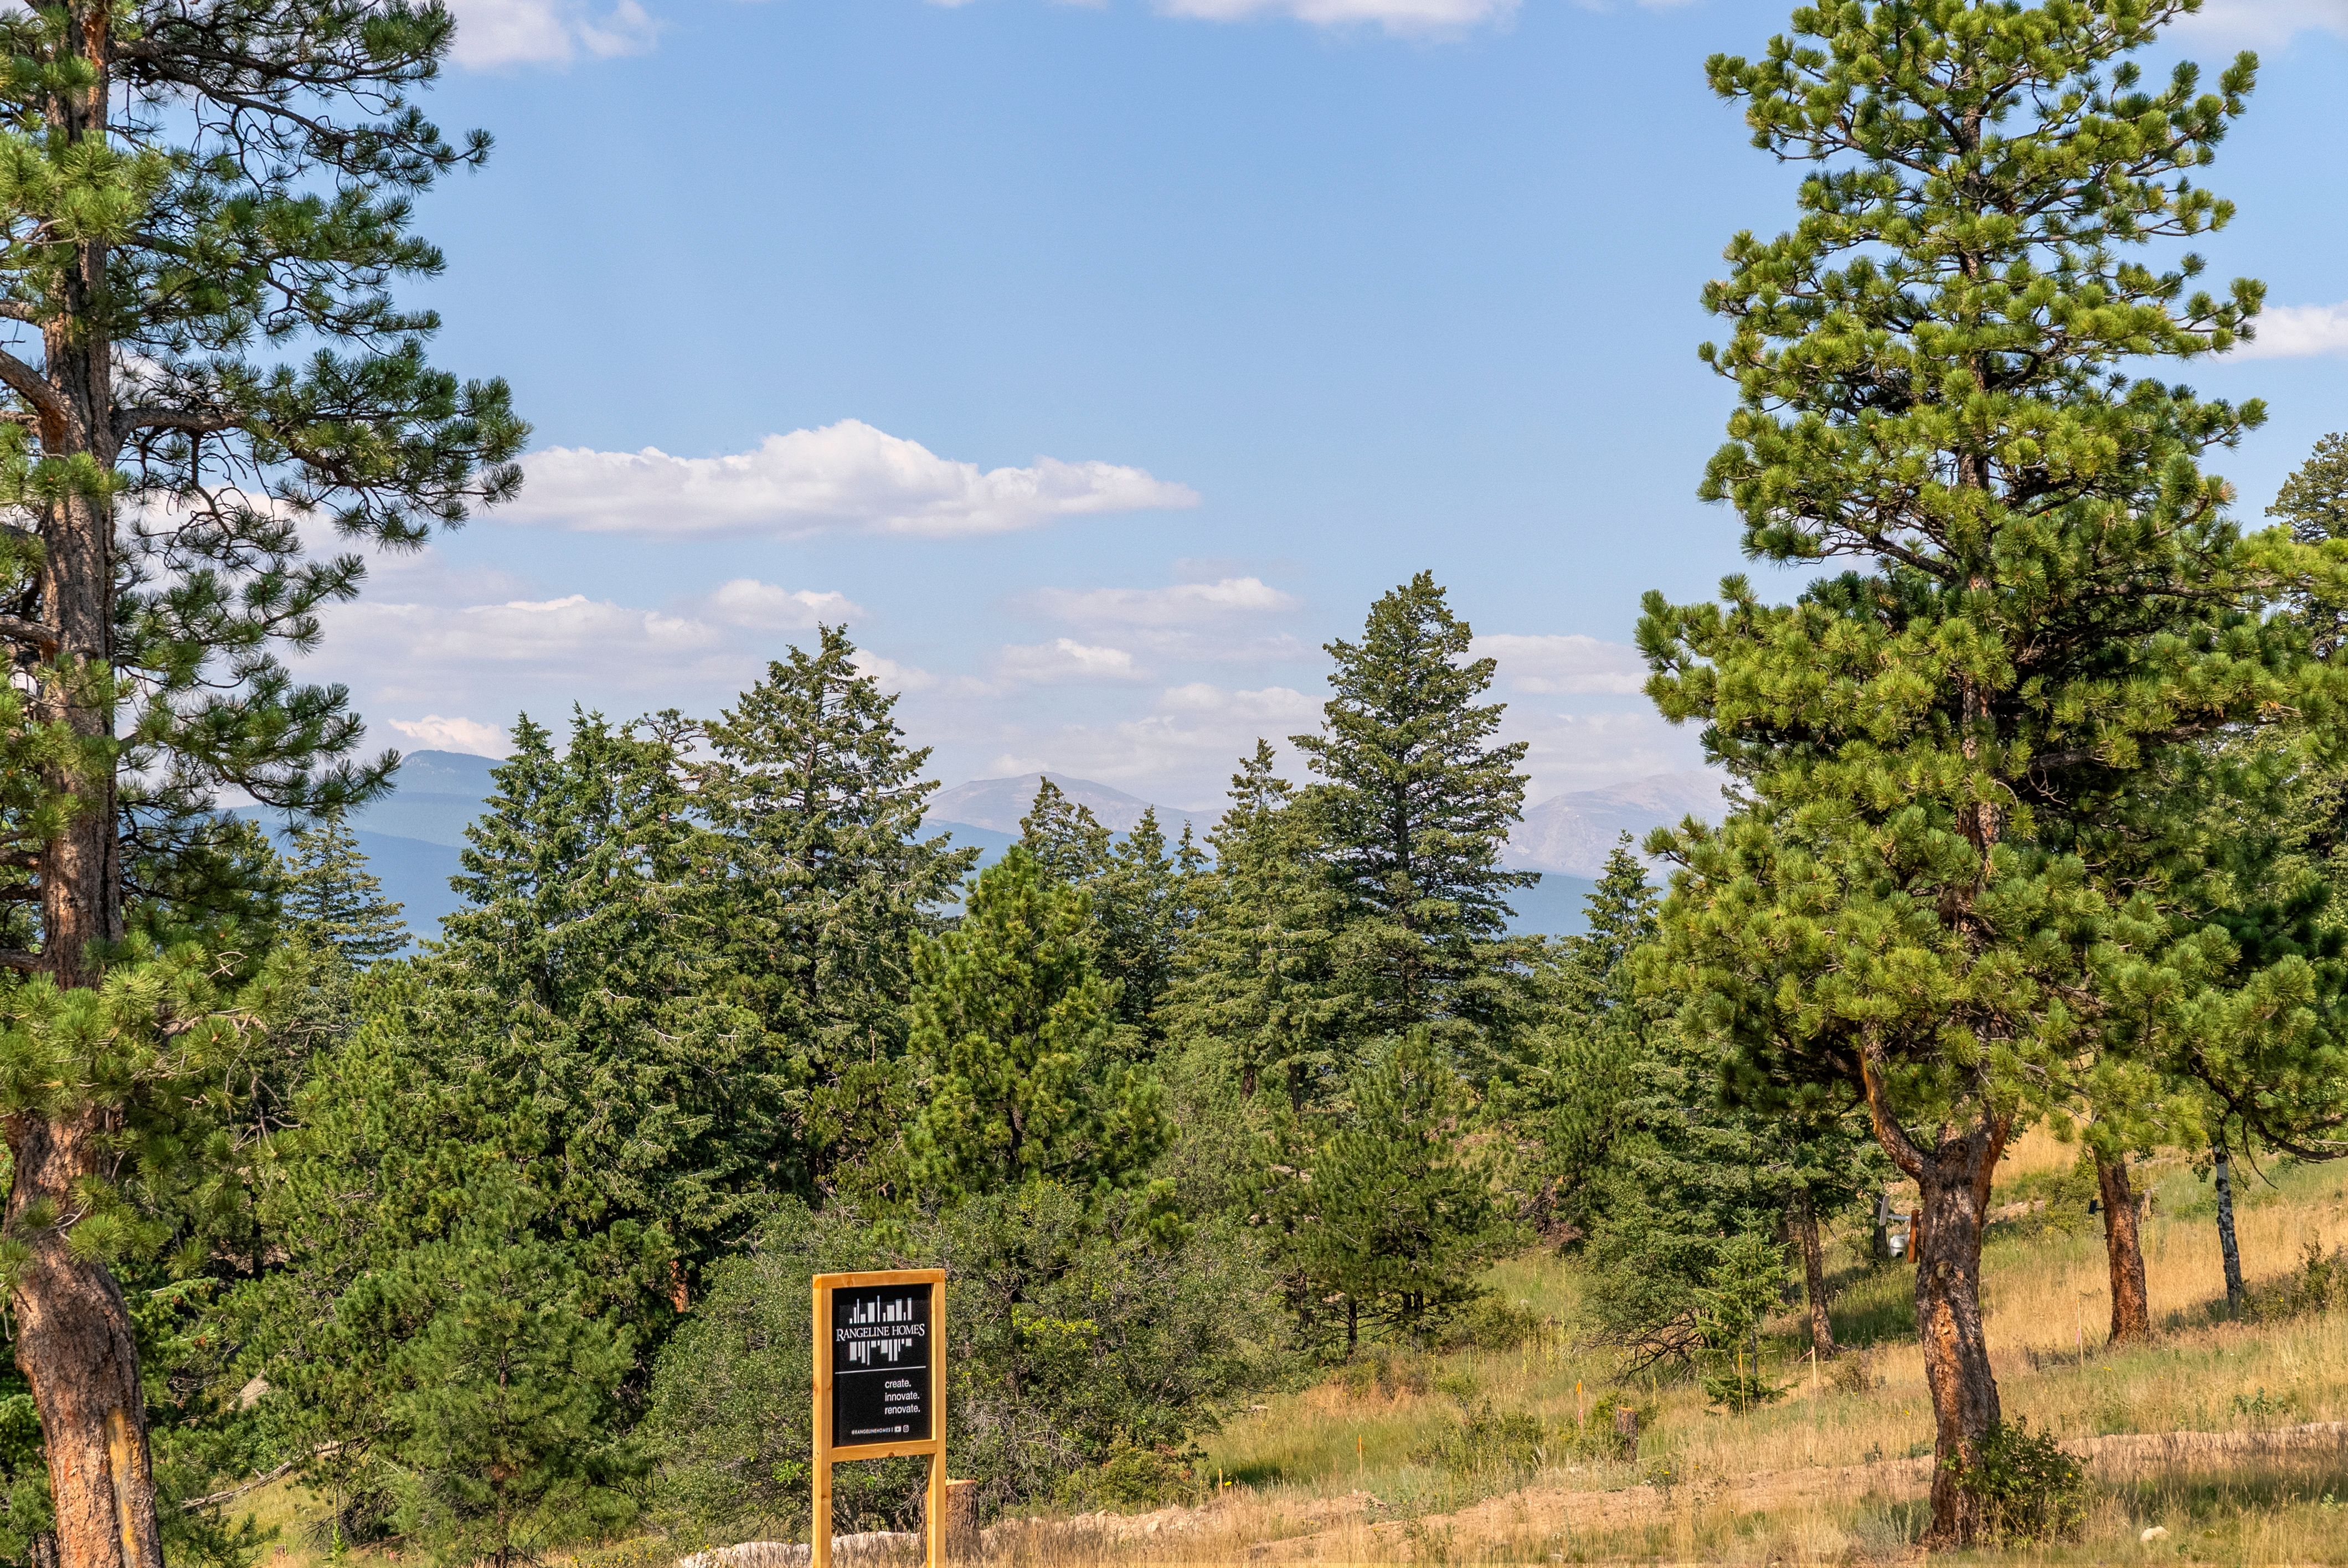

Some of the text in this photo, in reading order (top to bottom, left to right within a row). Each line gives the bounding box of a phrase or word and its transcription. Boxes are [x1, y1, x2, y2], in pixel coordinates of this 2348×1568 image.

[836, 1324, 925, 1342] RANGELINE HOMES
[884, 1378, 912, 1389] create.
[885, 1391, 920, 1402] innovate.
[884, 1404, 920, 1415] renovate.
